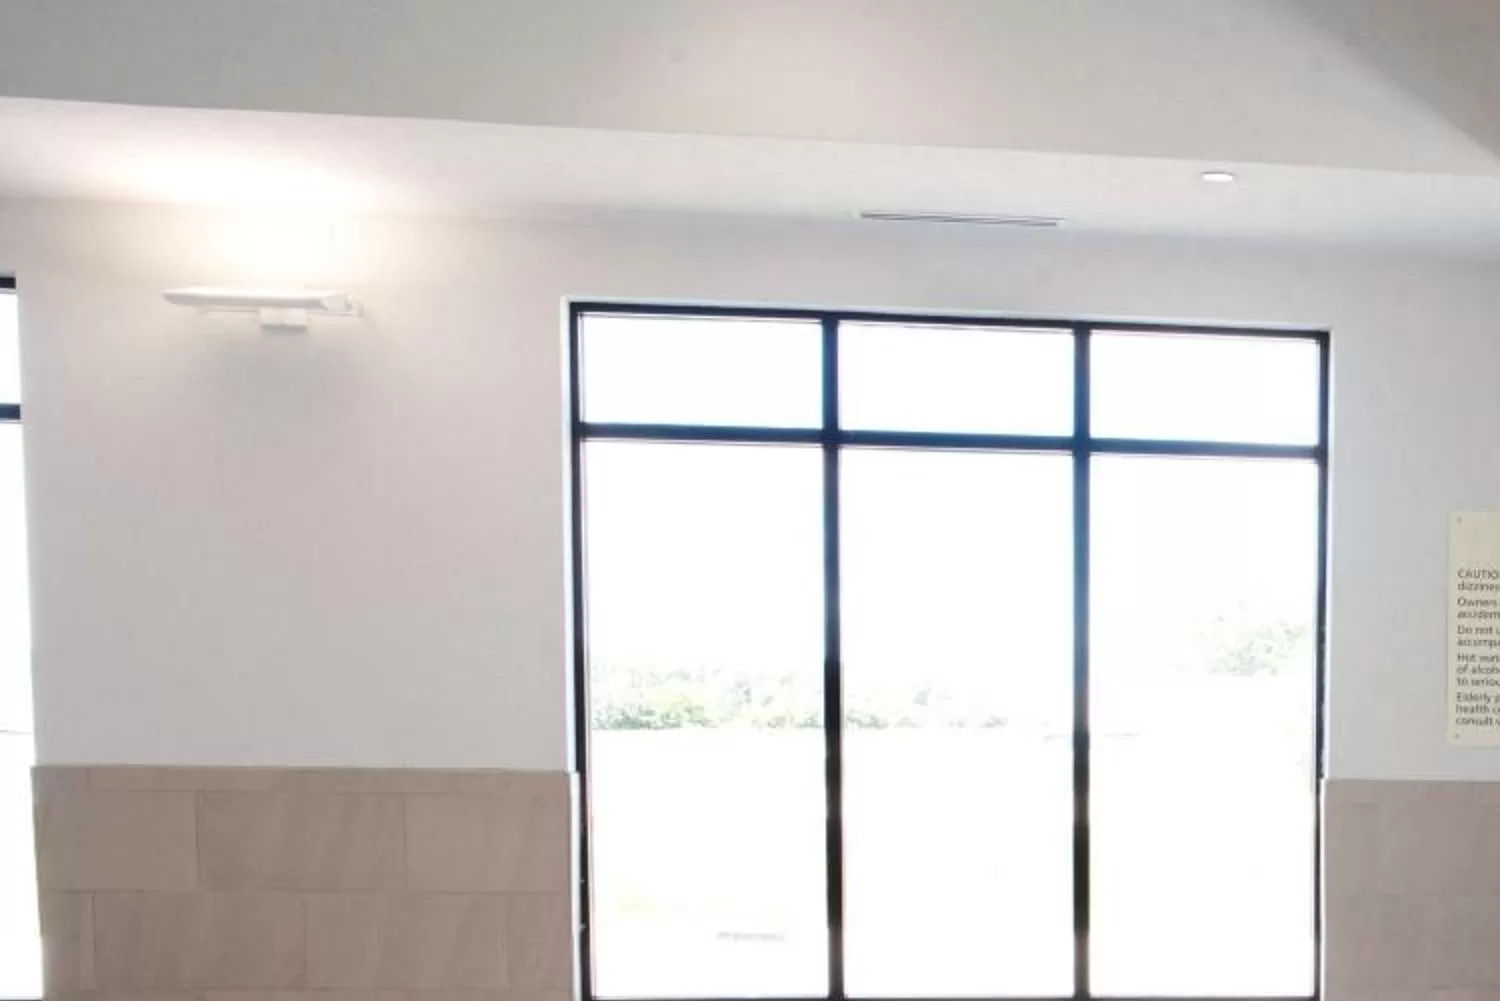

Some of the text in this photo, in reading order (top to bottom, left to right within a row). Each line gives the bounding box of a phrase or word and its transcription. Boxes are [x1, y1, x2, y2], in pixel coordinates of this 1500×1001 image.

[1457, 596, 1497, 608] Owners
[1457, 624, 1473, 635] Do
[1476, 626, 1493, 636] not
[1457, 653, 1475, 663] Hot
[1456, 665, 1468, 675] of
[1457, 678, 1468, 687] to
[1456, 692, 1491, 705] Elderly
[1456, 703, 1489, 715] health
[1456, 717, 1493, 728] consult
